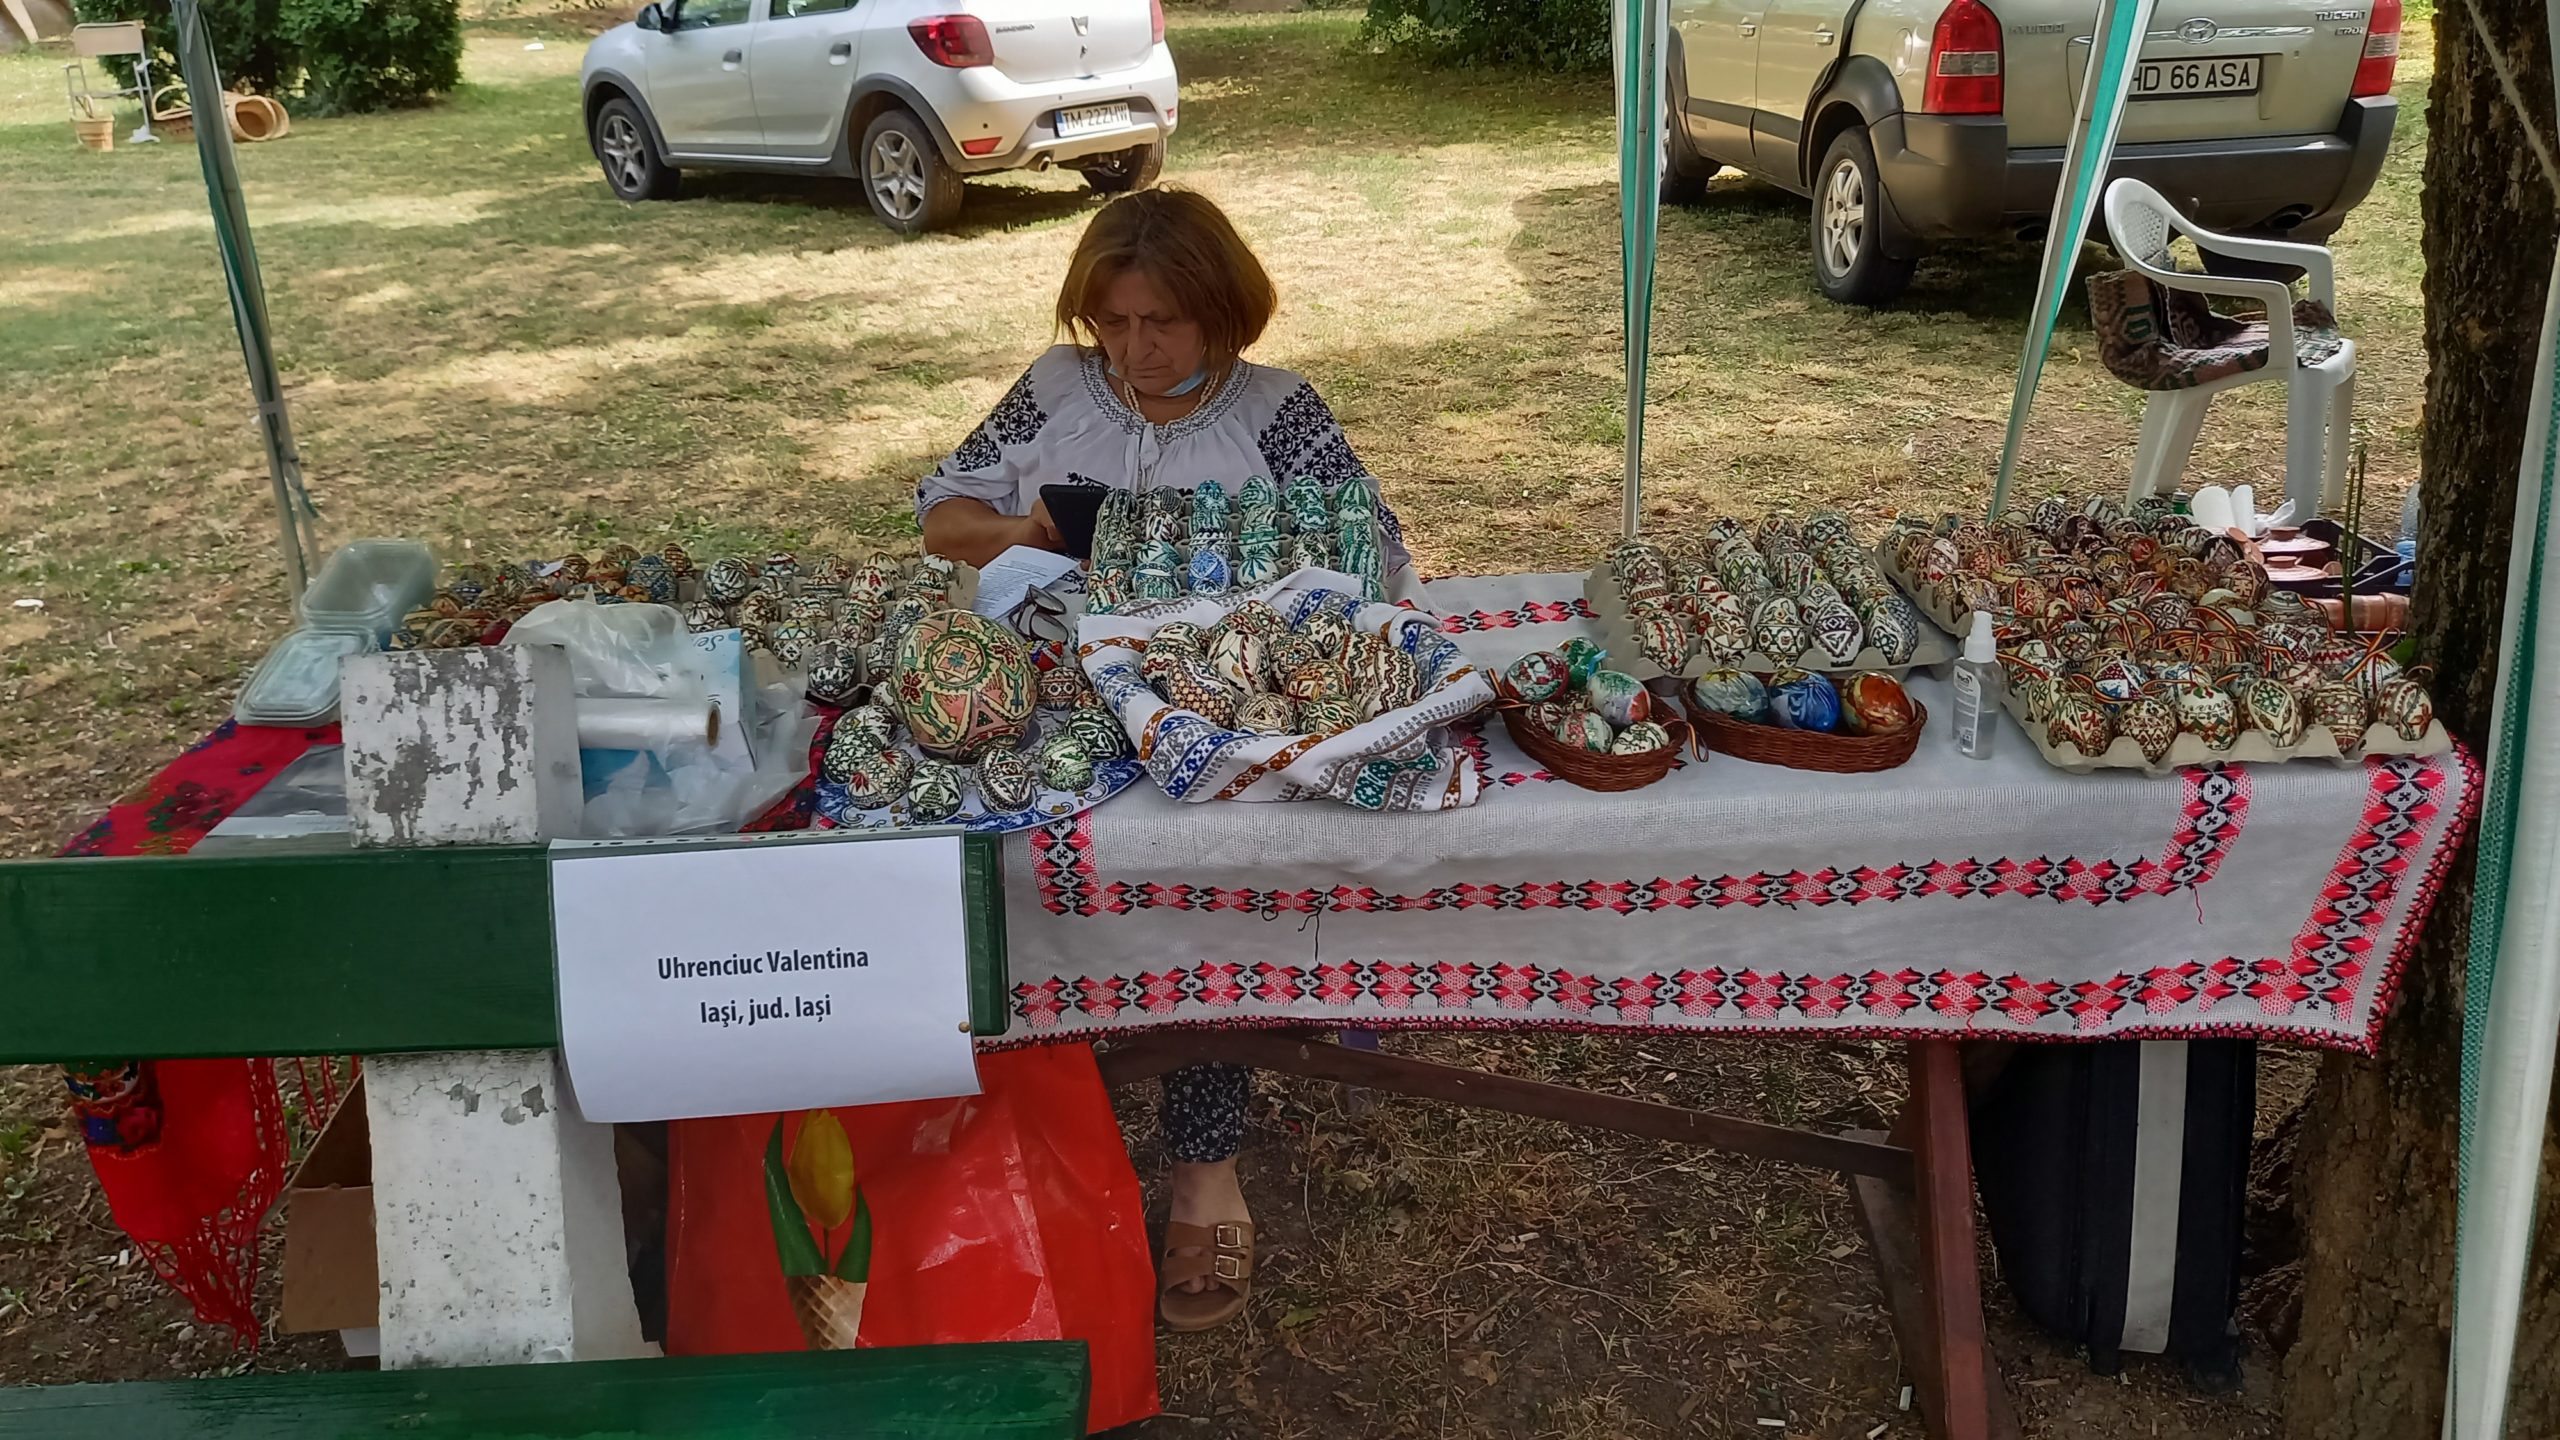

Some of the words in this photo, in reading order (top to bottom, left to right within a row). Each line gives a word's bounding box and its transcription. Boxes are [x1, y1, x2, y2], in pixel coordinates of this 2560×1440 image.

[2171, 64, 2200, 89] 66
[2205, 62, 2250, 88] ASA
[1063, 111, 1083, 130] TM
[658, 953, 763, 980] Uhrenciuc
[766, 947, 868, 973] Valentina
[748, 996, 790, 1026] jud.
